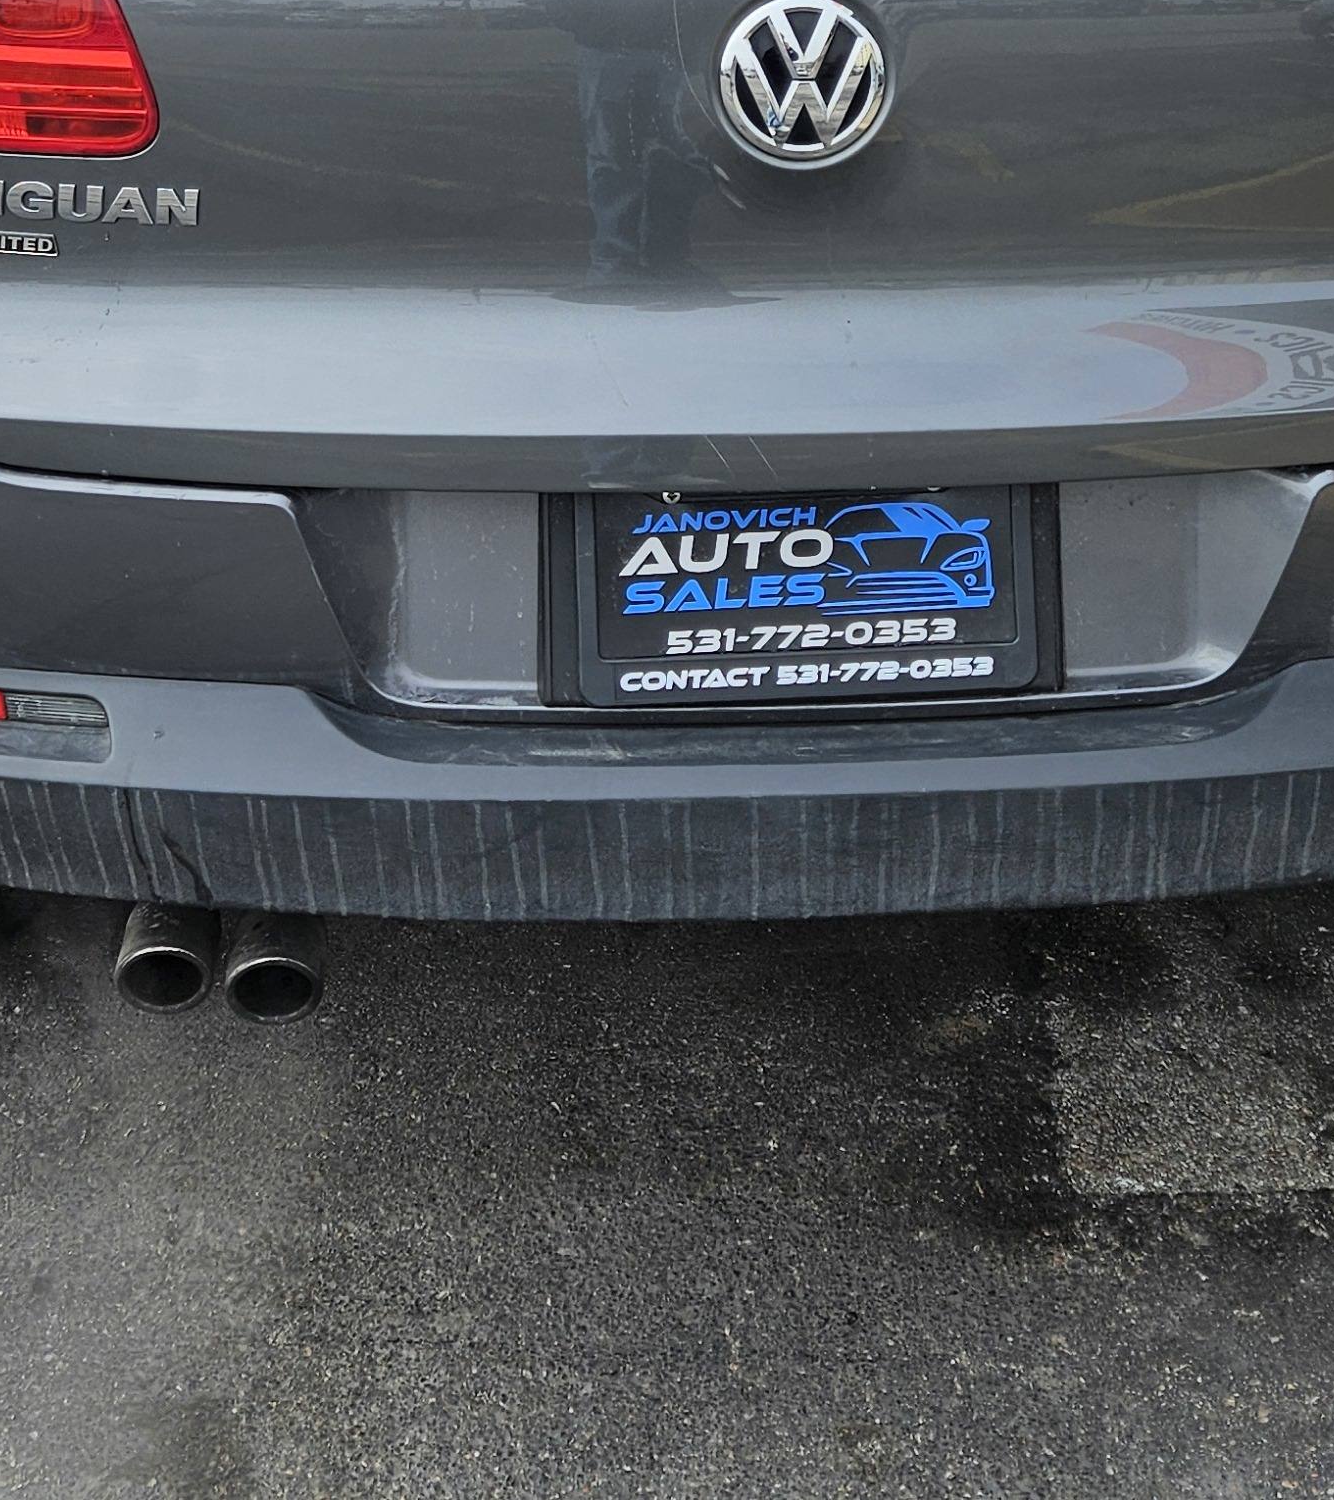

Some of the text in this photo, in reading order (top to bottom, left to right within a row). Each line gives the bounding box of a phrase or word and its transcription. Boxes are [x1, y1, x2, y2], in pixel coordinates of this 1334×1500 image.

[632, 506, 816, 534] JANOVICH
[618, 528, 834, 577] AUTO
[622, 572, 827, 615] SALES
[665, 617, 957, 656] 531-772-0353
[619, 656, 995, 692] CONTACT 531-772-0353
